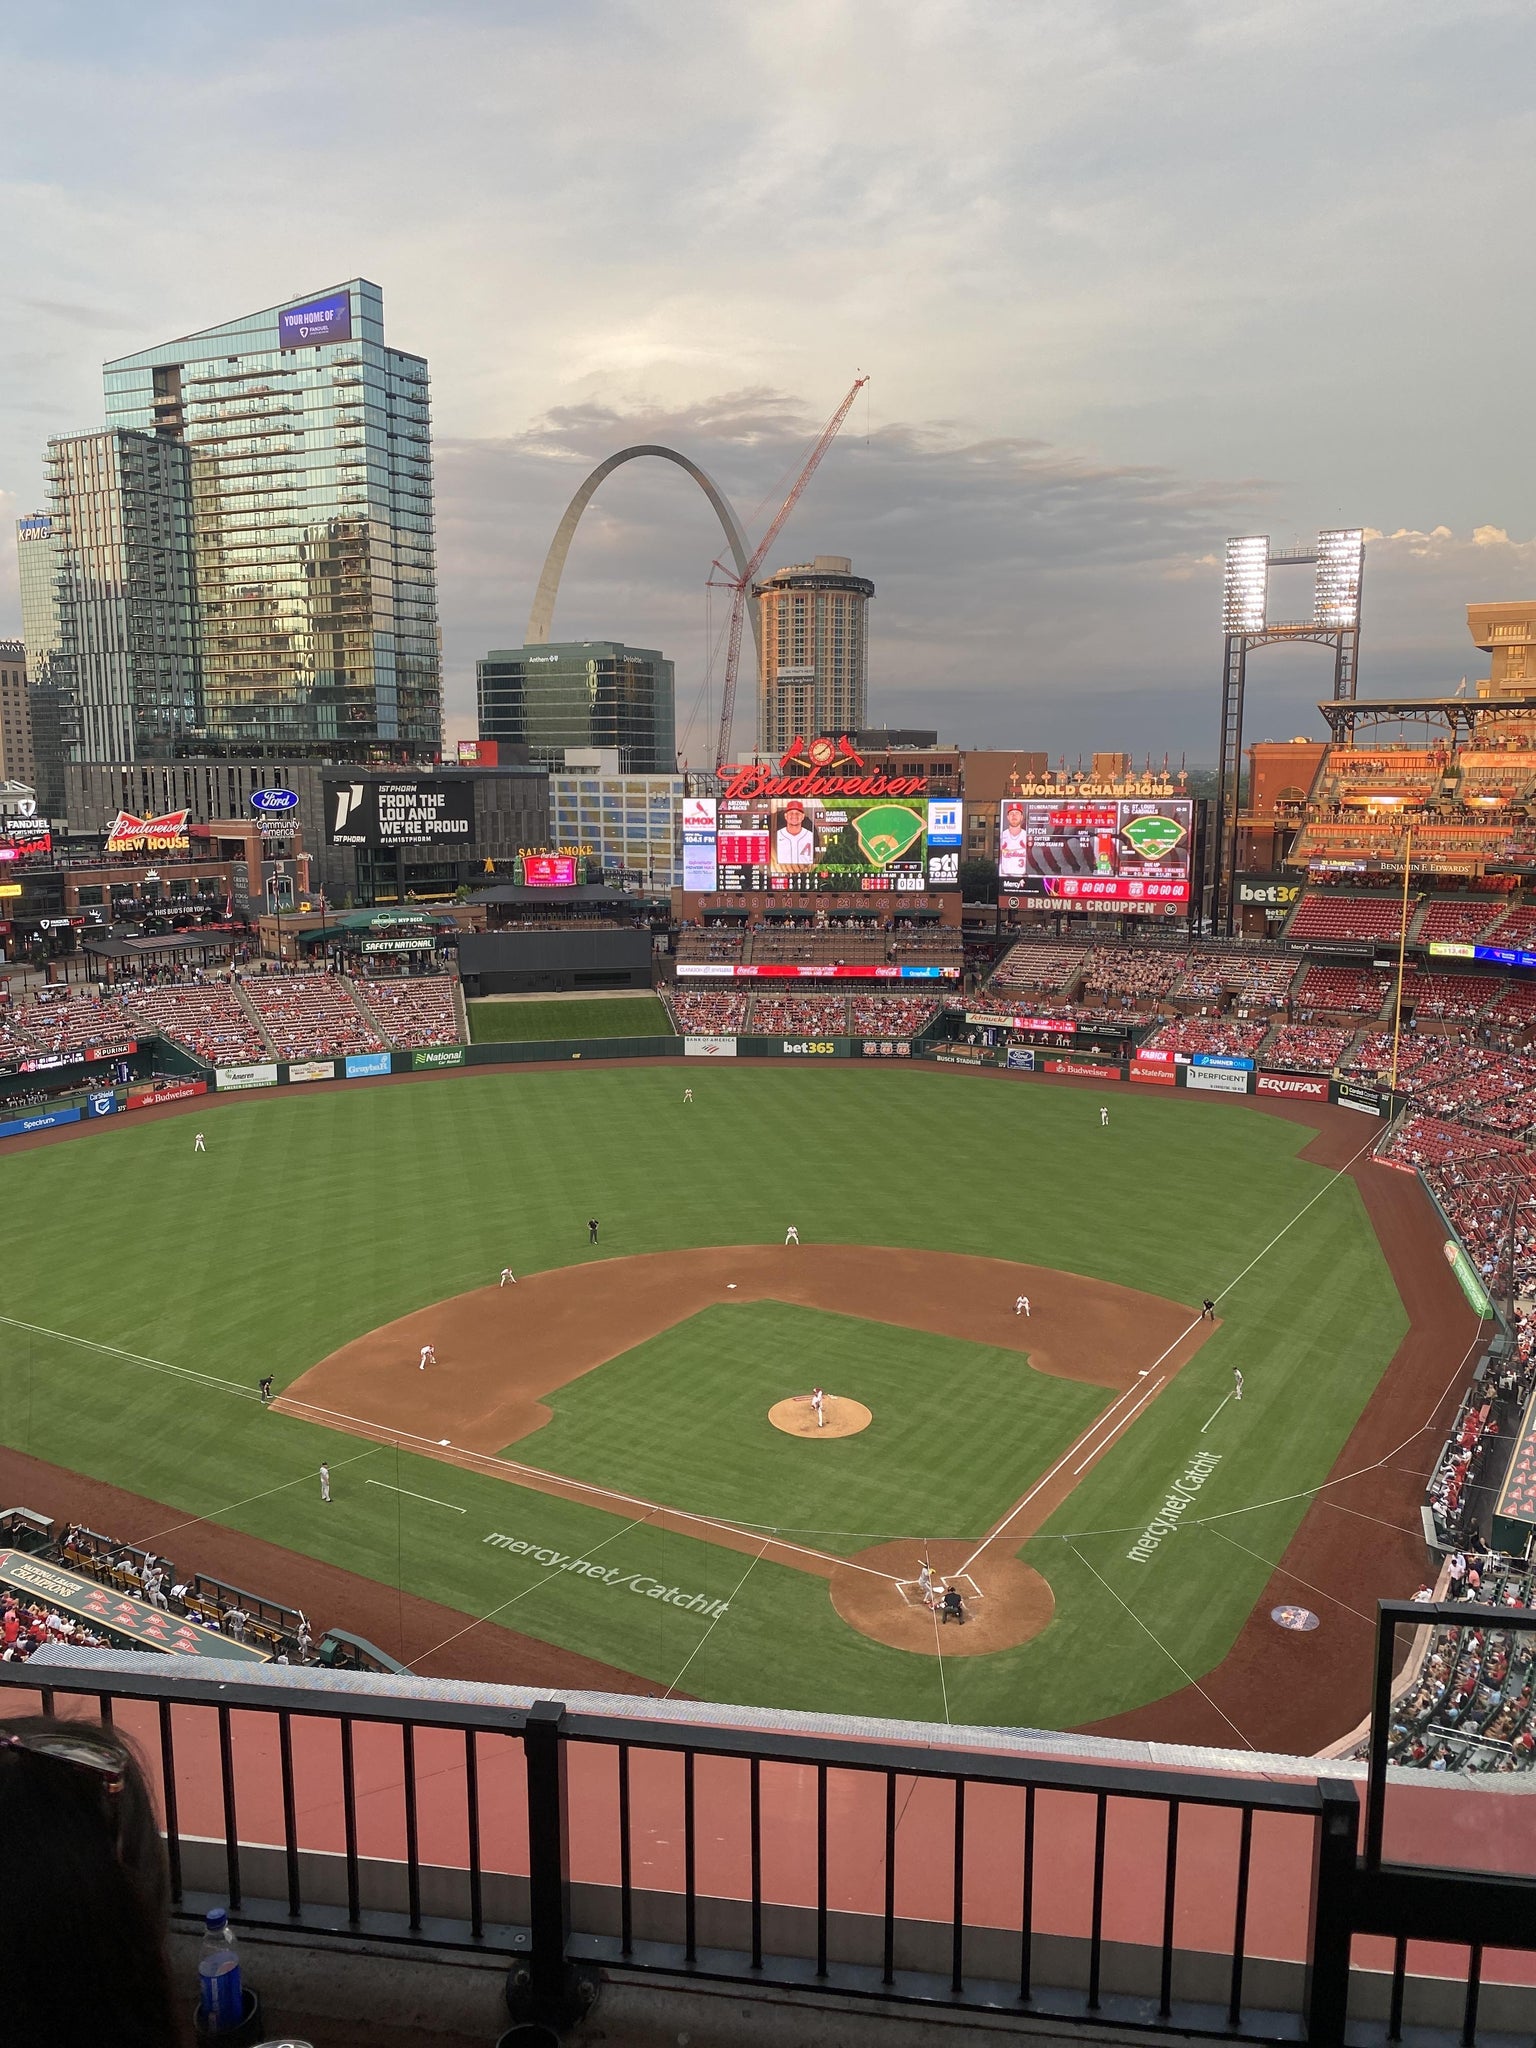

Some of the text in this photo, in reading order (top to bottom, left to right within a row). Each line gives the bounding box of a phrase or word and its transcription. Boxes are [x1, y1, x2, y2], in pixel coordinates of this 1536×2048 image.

[284, 309, 334, 326] YOUR HOME OF
[19, 526, 48, 541] KPMG
[528, 655, 549, 663] Anthem
[716, 763, 929, 799] Budweiser
[390, 785, 417, 793] PHORM
[1020, 783, 1174, 796] WORLD CHAMPIONS
[261, 791, 291, 807] Ford
[378, 794, 446, 808] FROM THE
[379, 807, 437, 821] LOU AND
[7, 819, 50, 829] FANDUEL
[257, 821, 300, 830] Community
[379, 820, 469, 834] WE'RE PROUD
[685, 817, 715, 825] KMOX
[107, 819, 188, 837] Budweiser
[108, 837, 190, 852] BREW HOUSE
[823, 835, 839, 845] 1-1
[519, 846, 593, 857] SALT SMOKE
[929, 853, 958, 871] stl
[1381, 862, 1419, 872] BENJAIN
[1430, 863, 1470, 873] EDWARDS
[1003, 880, 1021, 888] Mercy
[1081, 883, 1093, 893] GO
[1093, 883, 1105, 893] GO
[1105, 883, 1117, 893] GO
[1147, 885, 1159, 895] GO
[1159, 885, 1171, 895] GO
[1172, 886, 1184, 896] GO
[154, 905, 204, 916] THIS BUD'S FOR YOU
[1027, 898, 1072, 910] BROWN
[1086, 899, 1155, 914] CROUPPEN
[70, 917, 86, 926] Live!
[365, 939, 432, 950] SAFETY NATIONAL
[736, 966, 758, 975] Coca-Cola
[875, 967, 898, 976] Coca-Cola
[969, 1014, 1008, 1023] Schnucks
[1080, 1025, 1094, 1033] Mercy
[102, 1045, 128, 1056] PURINA
[783, 1041, 834, 1054] bet365
[426, 1050, 462, 1062] National
[937, 1054, 982, 1066] BUSCH STADIUM
[1013, 1050, 1028, 1060] Ford
[1141, 1050, 1168, 1061] FABICK
[232, 1072, 254, 1080] Ameren
[1067, 1065, 1109, 1077] Budweiser
[1198, 1072, 1246, 1083] PERFICIENT
[1257, 1078, 1323, 1094] EQUIFAX
[89, 1090, 114, 1100] CarShield
[155, 1087, 194, 1102] Budweiser
[1349, 1087, 1364, 1096] Cordell
[1364, 1091, 1379, 1100] Cordell
[23, 1116, 53, 1129] Spectrum
[1126, 1451, 1222, 1563] mercy.net/CatchIt
[20, 1563, 84, 1591] NATIONAL LEAGUE
[482, 1531, 730, 1619] mercy.net/CatchIt
[10, 1568, 76, 1598] CHAMPIONS
